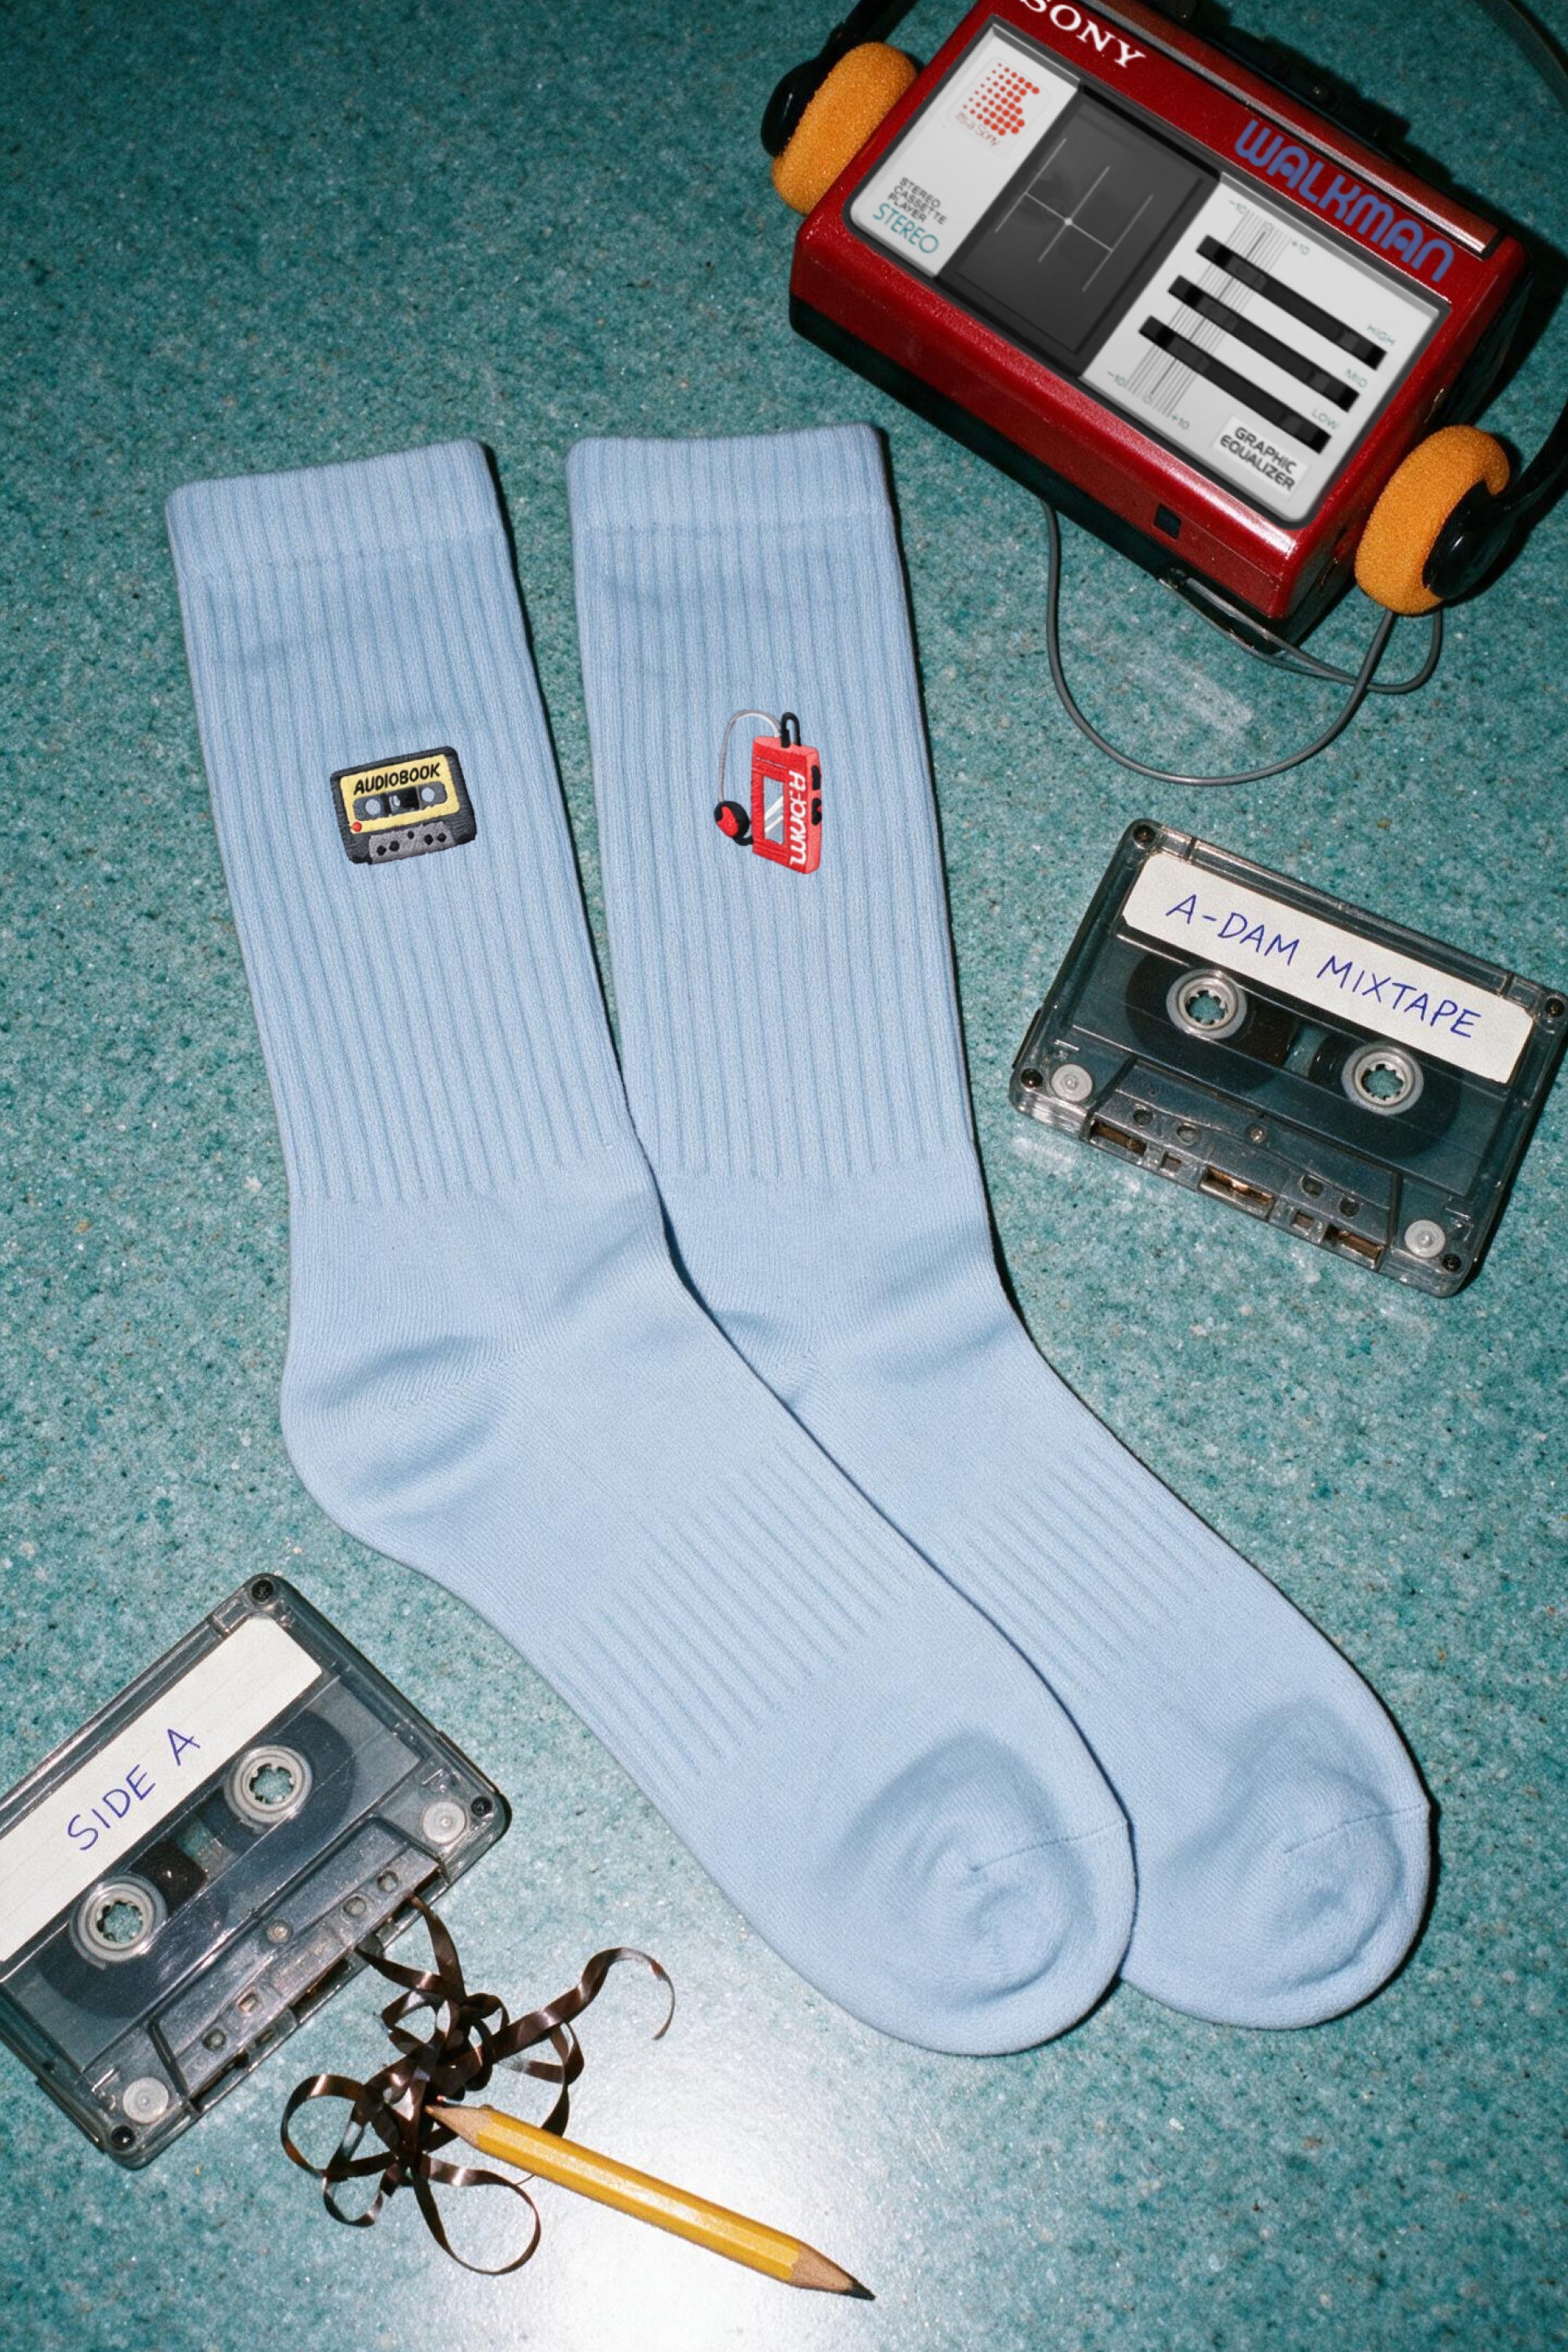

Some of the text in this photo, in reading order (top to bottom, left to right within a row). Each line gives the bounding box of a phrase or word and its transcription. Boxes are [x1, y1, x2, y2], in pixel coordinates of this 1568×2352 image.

[887, 192, 927, 222] PLAYER
[894, 185, 947, 225] CASSETTE
[900, 176, 941, 208] STEREO
[1235, 119, 1454, 283] WALKMAN
[873, 202, 939, 253] STEREO
[1367, 324, 1396, 346] HIGH
[1346, 368, 1367, 388] MID
[1312, 408, 1340, 430] LOW
[1220, 434, 1295, 492] EQUALIZER
[1234, 426, 1298, 475] GRAPHIC
[354, 762, 441, 796] AUDIOBOOK
[1165, 893, 1482, 1038] A-DAM MIXTAPE
[67, 1728, 201, 1851] SIDE A
